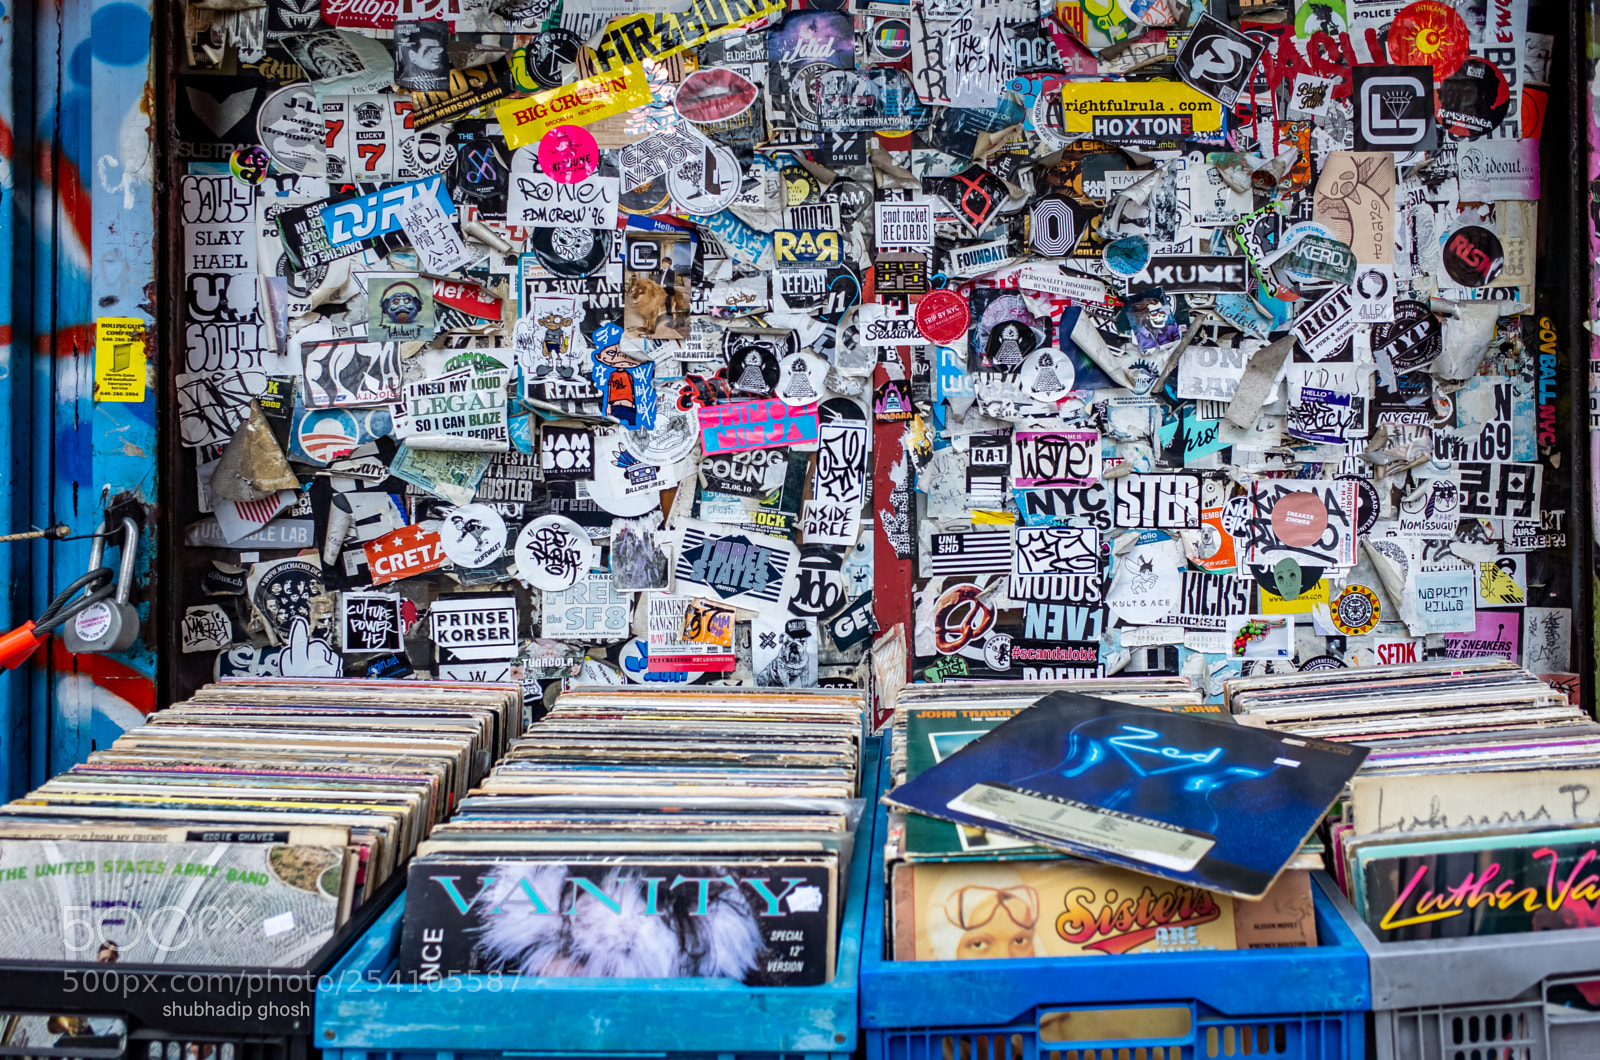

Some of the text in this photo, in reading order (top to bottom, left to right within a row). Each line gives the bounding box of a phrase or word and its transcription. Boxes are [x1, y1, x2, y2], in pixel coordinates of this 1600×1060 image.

[1354, 11, 1392, 20] POLICE
[512, 76, 628, 127] BIG CROWN
[1065, 99, 1213, 115] rightfulrula com
[545, 114, 574, 128] BROOKLYN
[1095, 117, 1191, 136] HOXTON FM
[358, 144, 386, 171] 7
[552, 153, 592, 172] KITSUNE
[883, 210, 928, 223] snot rocket
[654, 220, 675, 231] Hello
[883, 225, 928, 241] RECORDS
[195, 231, 245, 246] SLAY
[193, 254, 248, 269] HAEL
[302, 254, 319, 268] ON
[552, 279, 590, 294] SERVE
[1021, 273, 1101, 293] PERSONALITY DISORDERS
[1033, 283, 1086, 297] RUN THE WORLD
[946, 304, 960, 315] NYC
[866, 324, 923, 341] Sessions
[418, 381, 445, 396] NEED
[450, 379, 468, 393] MY
[472, 376, 501, 390] LOUD
[1303, 389, 1327, 398] HELLO
[411, 391, 505, 417] LEGAL
[415, 419, 432, 432] SO
[443, 417, 466, 430] CAN
[469, 412, 501, 427] BLAZE
[702, 400, 816, 428] SHINOBI
[468, 427, 506, 440] PEOPLE
[718, 421, 804, 449] NINJA
[544, 434, 591, 450] JAM
[543, 451, 591, 468] BOX
[732, 449, 784, 466] DOG
[721, 482, 752, 493] 23.06.10
[1025, 484, 1107, 515] NYC
[804, 505, 852, 521] INSIDE
[1286, 510, 1314, 521] SNEAKER
[804, 522, 852, 537] FORCE
[1285, 517, 1311, 527] ZIMMER
[281, 525, 308, 543] LAB
[938, 535, 959, 545] UNL
[1515, 528, 1536, 536] WAS
[701, 539, 772, 567] THREE
[938, 544, 959, 554] SHD
[208, 571, 244, 587] djbus.ch
[691, 559, 770, 592] STATES
[1010, 575, 1102, 601] MODUS
[1180, 572, 1248, 615] KICKS
[1418, 587, 1468, 599] NAPKIN
[347, 599, 394, 620] CULTURE
[1151, 599, 1171, 607] ACE
[351, 617, 398, 634] POWER
[437, 611, 509, 627] PRINSE
[565, 607, 627, 631] SF8
[363, 631, 386, 649] 45
[437, 627, 510, 643] KORSER
[1012, 645, 1097, 661] #scandalobk
[1446, 639, 1512, 651] MY SNEAKERS
[916, 710, 958, 719] JOHN
[203, 832, 274, 842] EDDIE CHAVEZ
[35, 860, 96, 878] UNITED
[103, 860, 166, 876] STATES
[173, 863, 220, 879] ARMY
[226, 868, 270, 886] BAND
[430, 875, 808, 916] VANITY
[1380, 863, 1542, 930] Luther
[1056, 884, 1221, 943] Sisters
[770, 930, 804, 942] SPECIAL
[1155, 926, 1200, 943] ARE
[767, 961, 804, 973] VERSION
